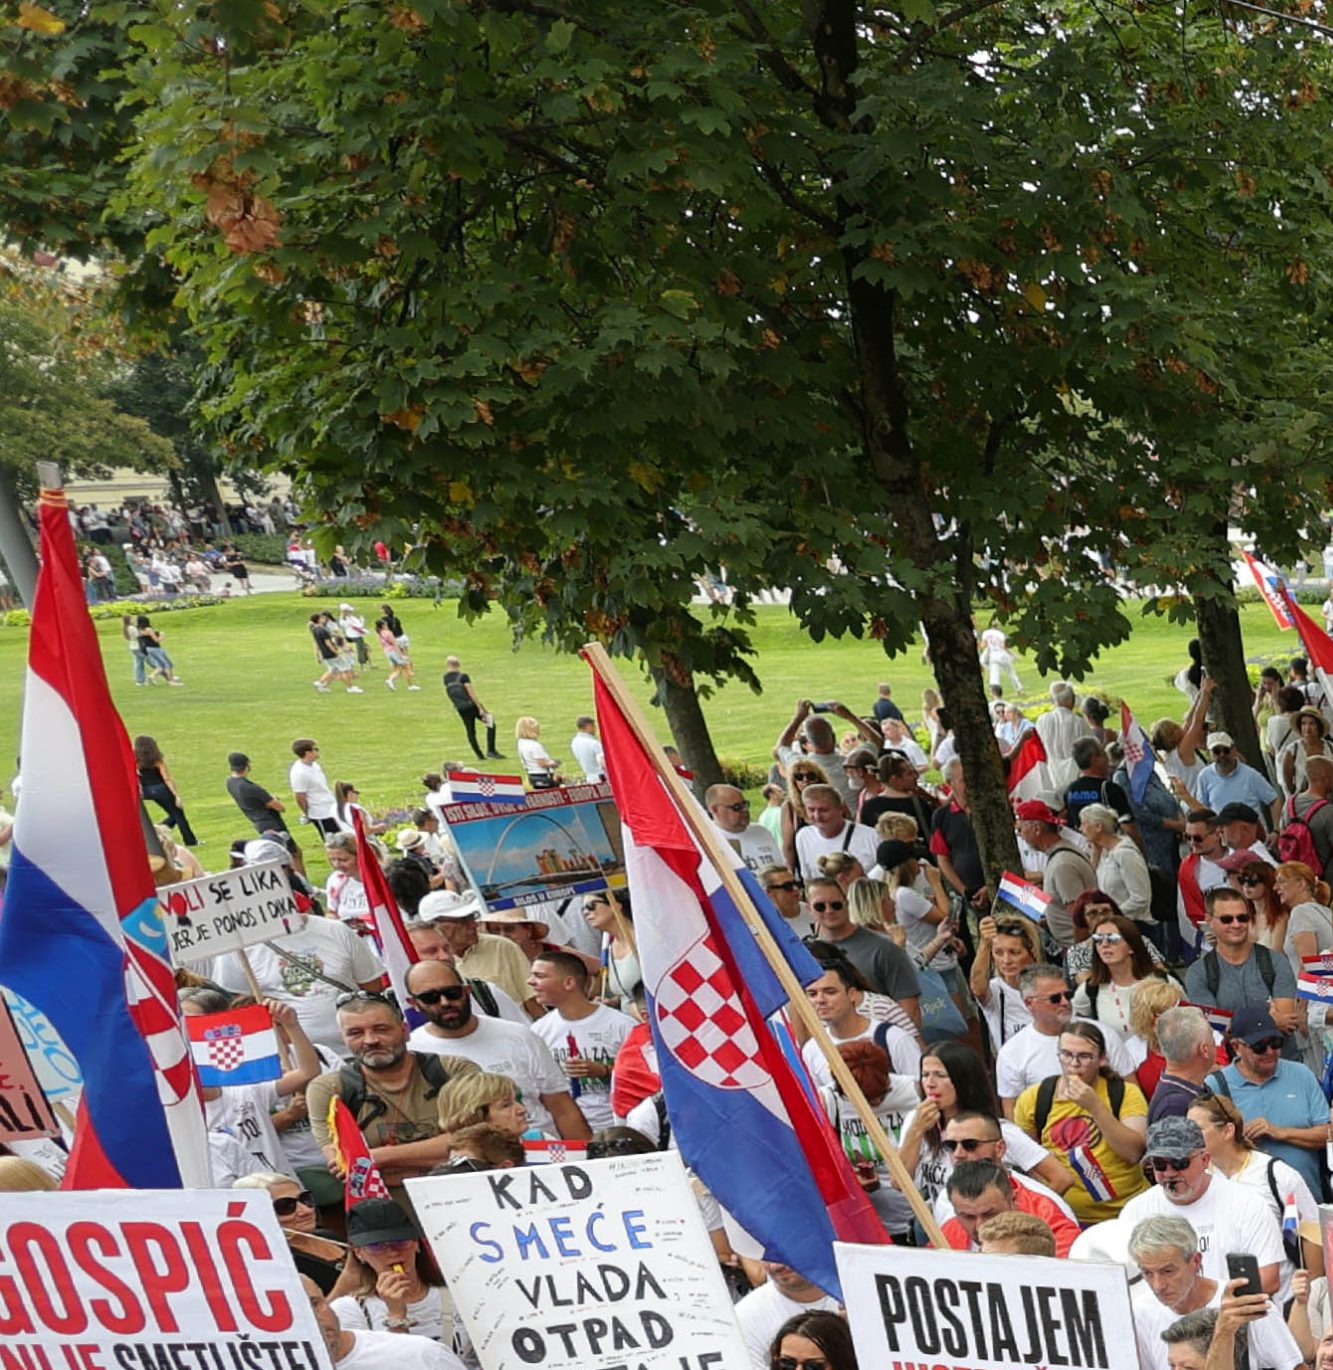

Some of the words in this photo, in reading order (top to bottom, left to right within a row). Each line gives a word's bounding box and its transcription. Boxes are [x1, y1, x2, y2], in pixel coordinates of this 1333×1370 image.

[208, 879, 234, 903] SE
[240, 869, 283, 896] LIKA
[171, 928, 196, 952] JER
[195, 921, 209, 943] JE
[212, 907, 258, 936] PONOS
[487, 1165, 594, 1210] KAD
[469, 1202, 654, 1264] SMEĆE
[515, 1260, 668, 1309] VLADA
[511, 1309, 674, 1364] OTPAD
[874, 1271, 1110, 1370] POSTAJEM
